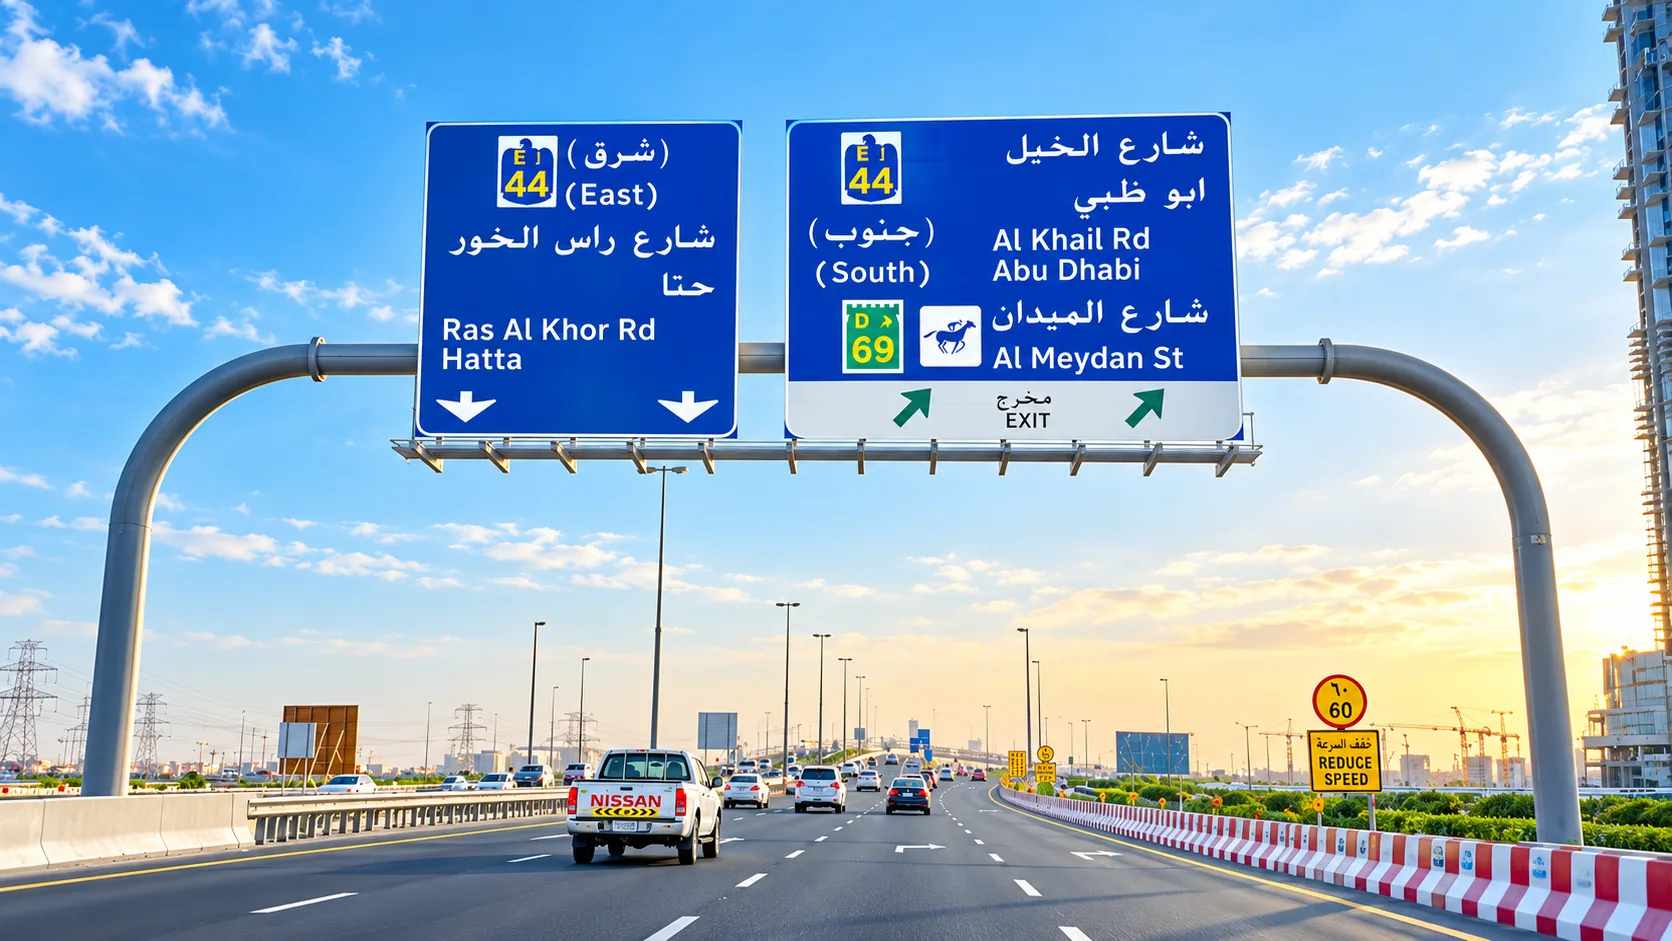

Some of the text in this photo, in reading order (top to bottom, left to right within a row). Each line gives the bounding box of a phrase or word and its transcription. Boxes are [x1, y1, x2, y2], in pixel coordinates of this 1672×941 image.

[513, 149, 527, 166] E
[857, 145, 869, 162] E
[1006, 130, 1204, 166] شارع الخيل
[505, 170, 550, 198] 44
[849, 166, 895, 195] 44
[565, 181, 658, 211] (East)
[1074, 177, 1205, 220] ابو ظبي
[448, 224, 715, 259] شارع راس الخور
[992, 226, 1150, 252] Al Khail Rd
[815, 259, 931, 289] (South)
[992, 257, 1141, 282] Abu Dhabi
[662, 272, 715, 296] حتا
[855, 312, 870, 329] D
[992, 298, 1209, 334] شارع الميدان
[443, 317, 656, 341] Ras Al Khor Rd
[442, 347, 522, 370] Hatta
[852, 335, 895, 364] 69
[992, 345, 1184, 375] Al Meydan St
[997, 390, 1052, 411] مخرج
[1006, 412, 1051, 429] EXIT
[1329, 701, 1353, 719] 60
[1316, 736, 1372, 753] خفف السرعة
[1318, 755, 1373, 770] REDUCE
[1324, 772, 1369, 786] SPEED
[590, 794, 662, 808] NISSAN
